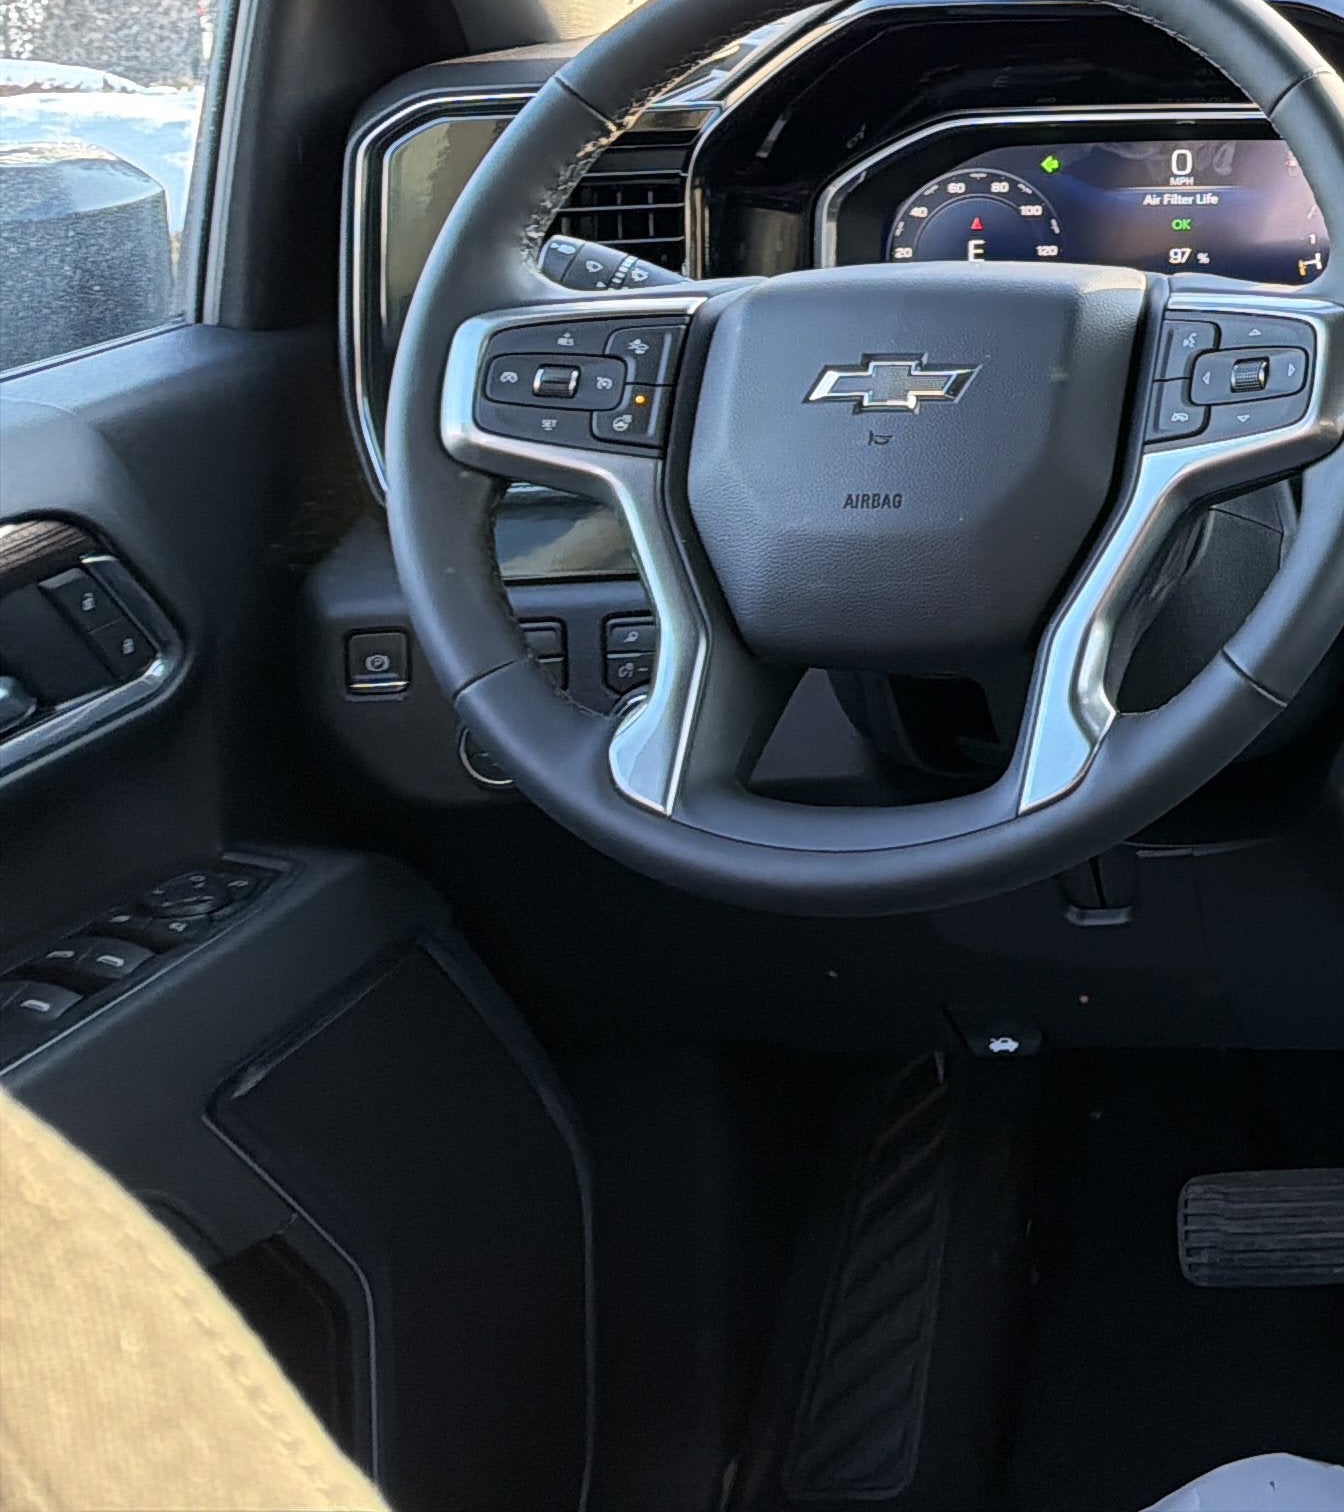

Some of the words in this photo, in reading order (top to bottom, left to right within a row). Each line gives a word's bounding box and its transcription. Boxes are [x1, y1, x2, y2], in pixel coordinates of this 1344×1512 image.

[1171, 149, 1192, 176] 0
[1170, 177, 1194, 186] MPH
[1143, 195, 1161, 205] Air
[1163, 194, 1194, 205] Filter
[1196, 193, 1218, 204] Life
[910, 207, 928, 218] 40
[1019, 205, 1043, 216] 100
[1171, 219, 1192, 230] OK
[894, 248, 913, 258] 20
[968, 240, 986, 263] E
[1036, 245, 1058, 256] 120
[1169, 248, 1192, 264] 97
[1197, 252, 1210, 264] %
[842, 494, 903, 509] AIRBAG
